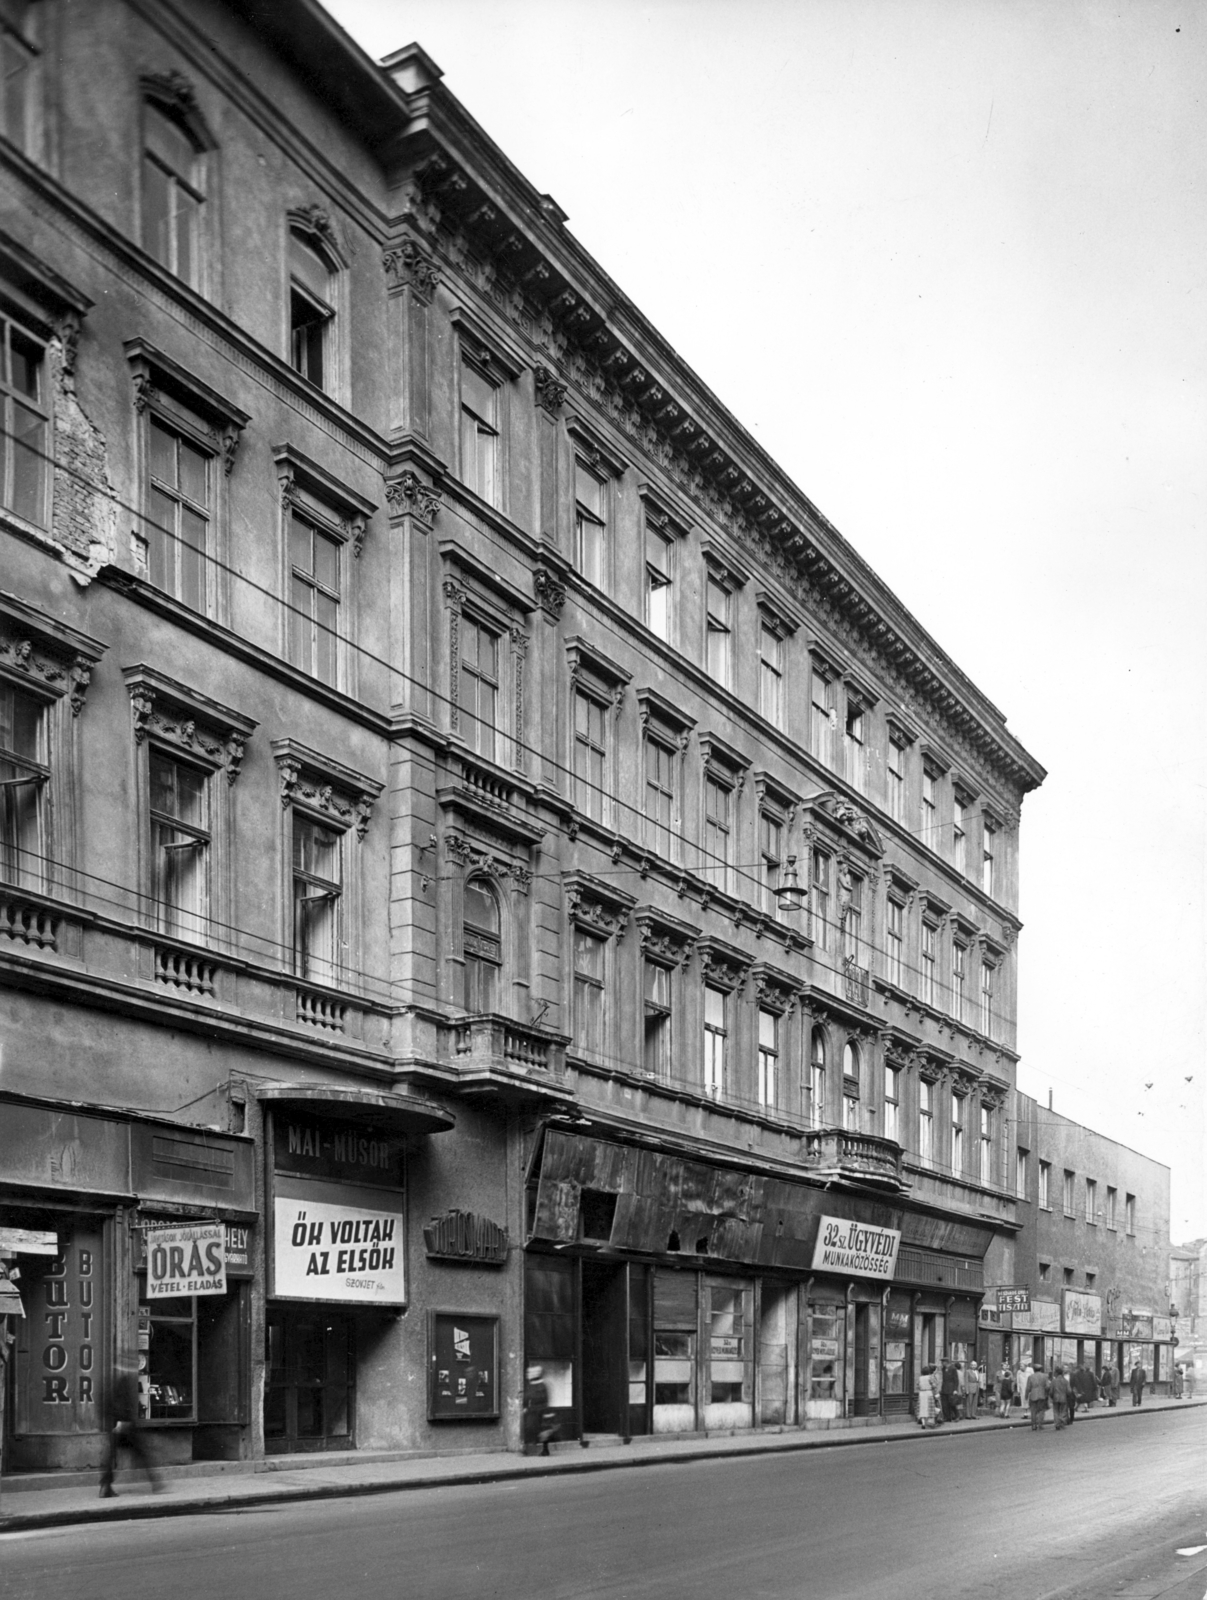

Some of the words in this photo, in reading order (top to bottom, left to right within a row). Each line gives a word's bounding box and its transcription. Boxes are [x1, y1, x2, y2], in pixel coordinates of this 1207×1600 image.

[225, 1227, 249, 1249] HELY
[330, 1219, 395, 1244] VOLTAK
[847, 1223, 896, 1258] ÜGYVÉDI
[306, 1251, 330, 1276] AZ
[822, 1250, 889, 1274] MUNKAKÖZÖSSÉG
[345, 1278, 375, 1290] SZOVJET
[999, 1294, 1029, 1303] FEST
